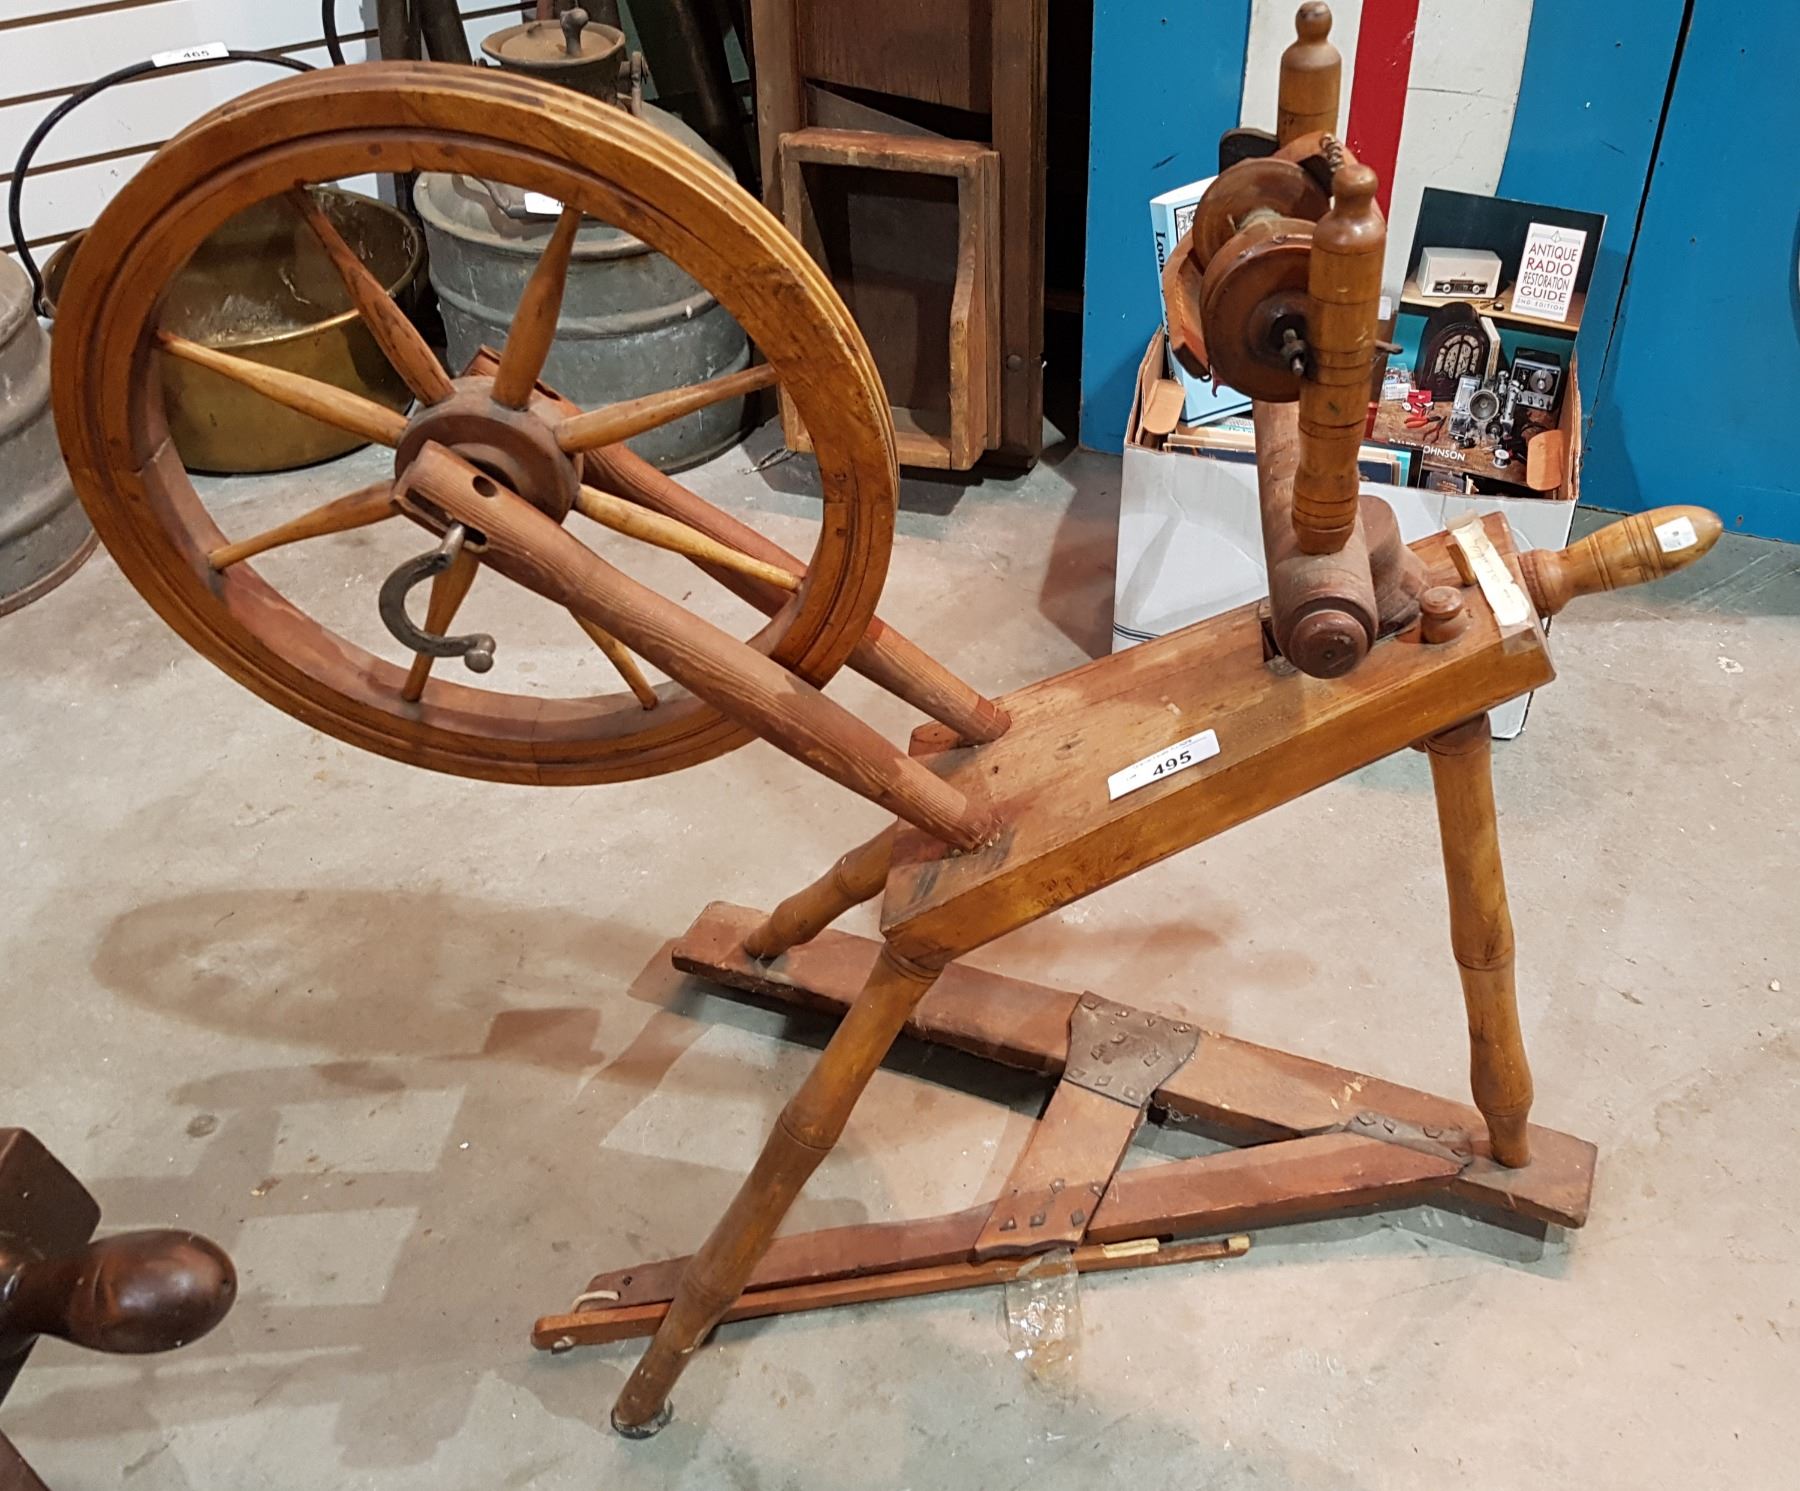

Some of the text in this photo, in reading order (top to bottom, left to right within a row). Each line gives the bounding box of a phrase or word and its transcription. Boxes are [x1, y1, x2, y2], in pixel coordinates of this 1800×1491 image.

[1528, 242, 1579, 262] ANTIQUE
[1526, 257, 1573, 277] RADIO
[1522, 271, 1570, 291] RESTORATION
[1520, 285, 1567, 303] GUIDE
[1534, 300, 1565, 311] EDITION
[1153, 750, 1192, 776] 495
